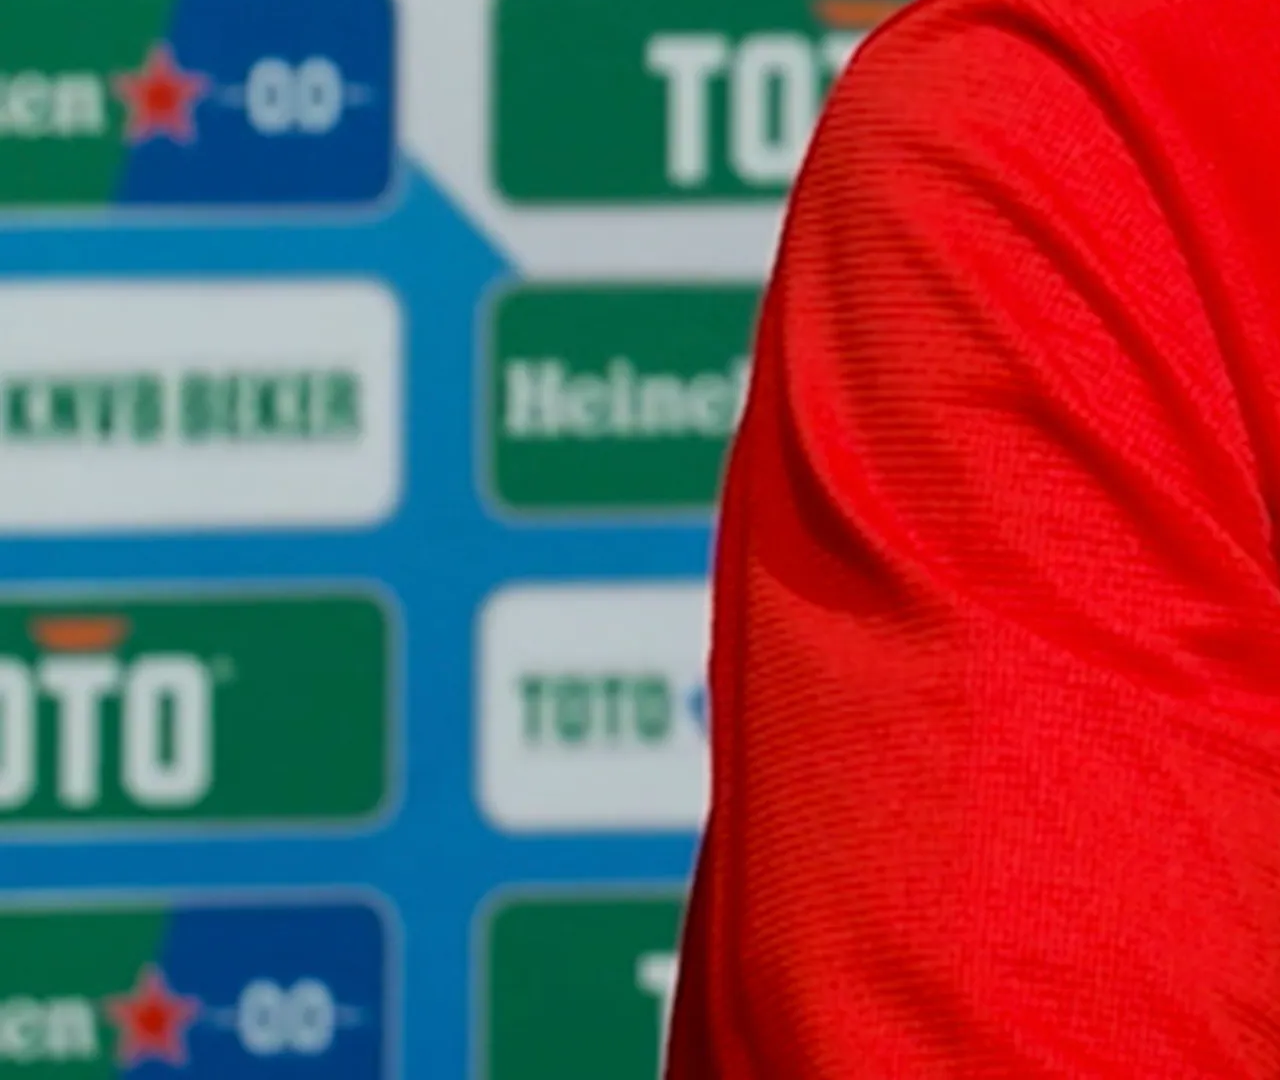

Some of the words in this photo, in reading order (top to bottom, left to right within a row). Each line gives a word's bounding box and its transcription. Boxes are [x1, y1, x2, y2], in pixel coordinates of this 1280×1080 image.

[0, 72, 106, 137] en
[646, 32, 848, 186] TO
[3, 372, 165, 444] KNVB
[177, 370, 361, 445] BEKER
[518, 672, 676, 746] TOTO
